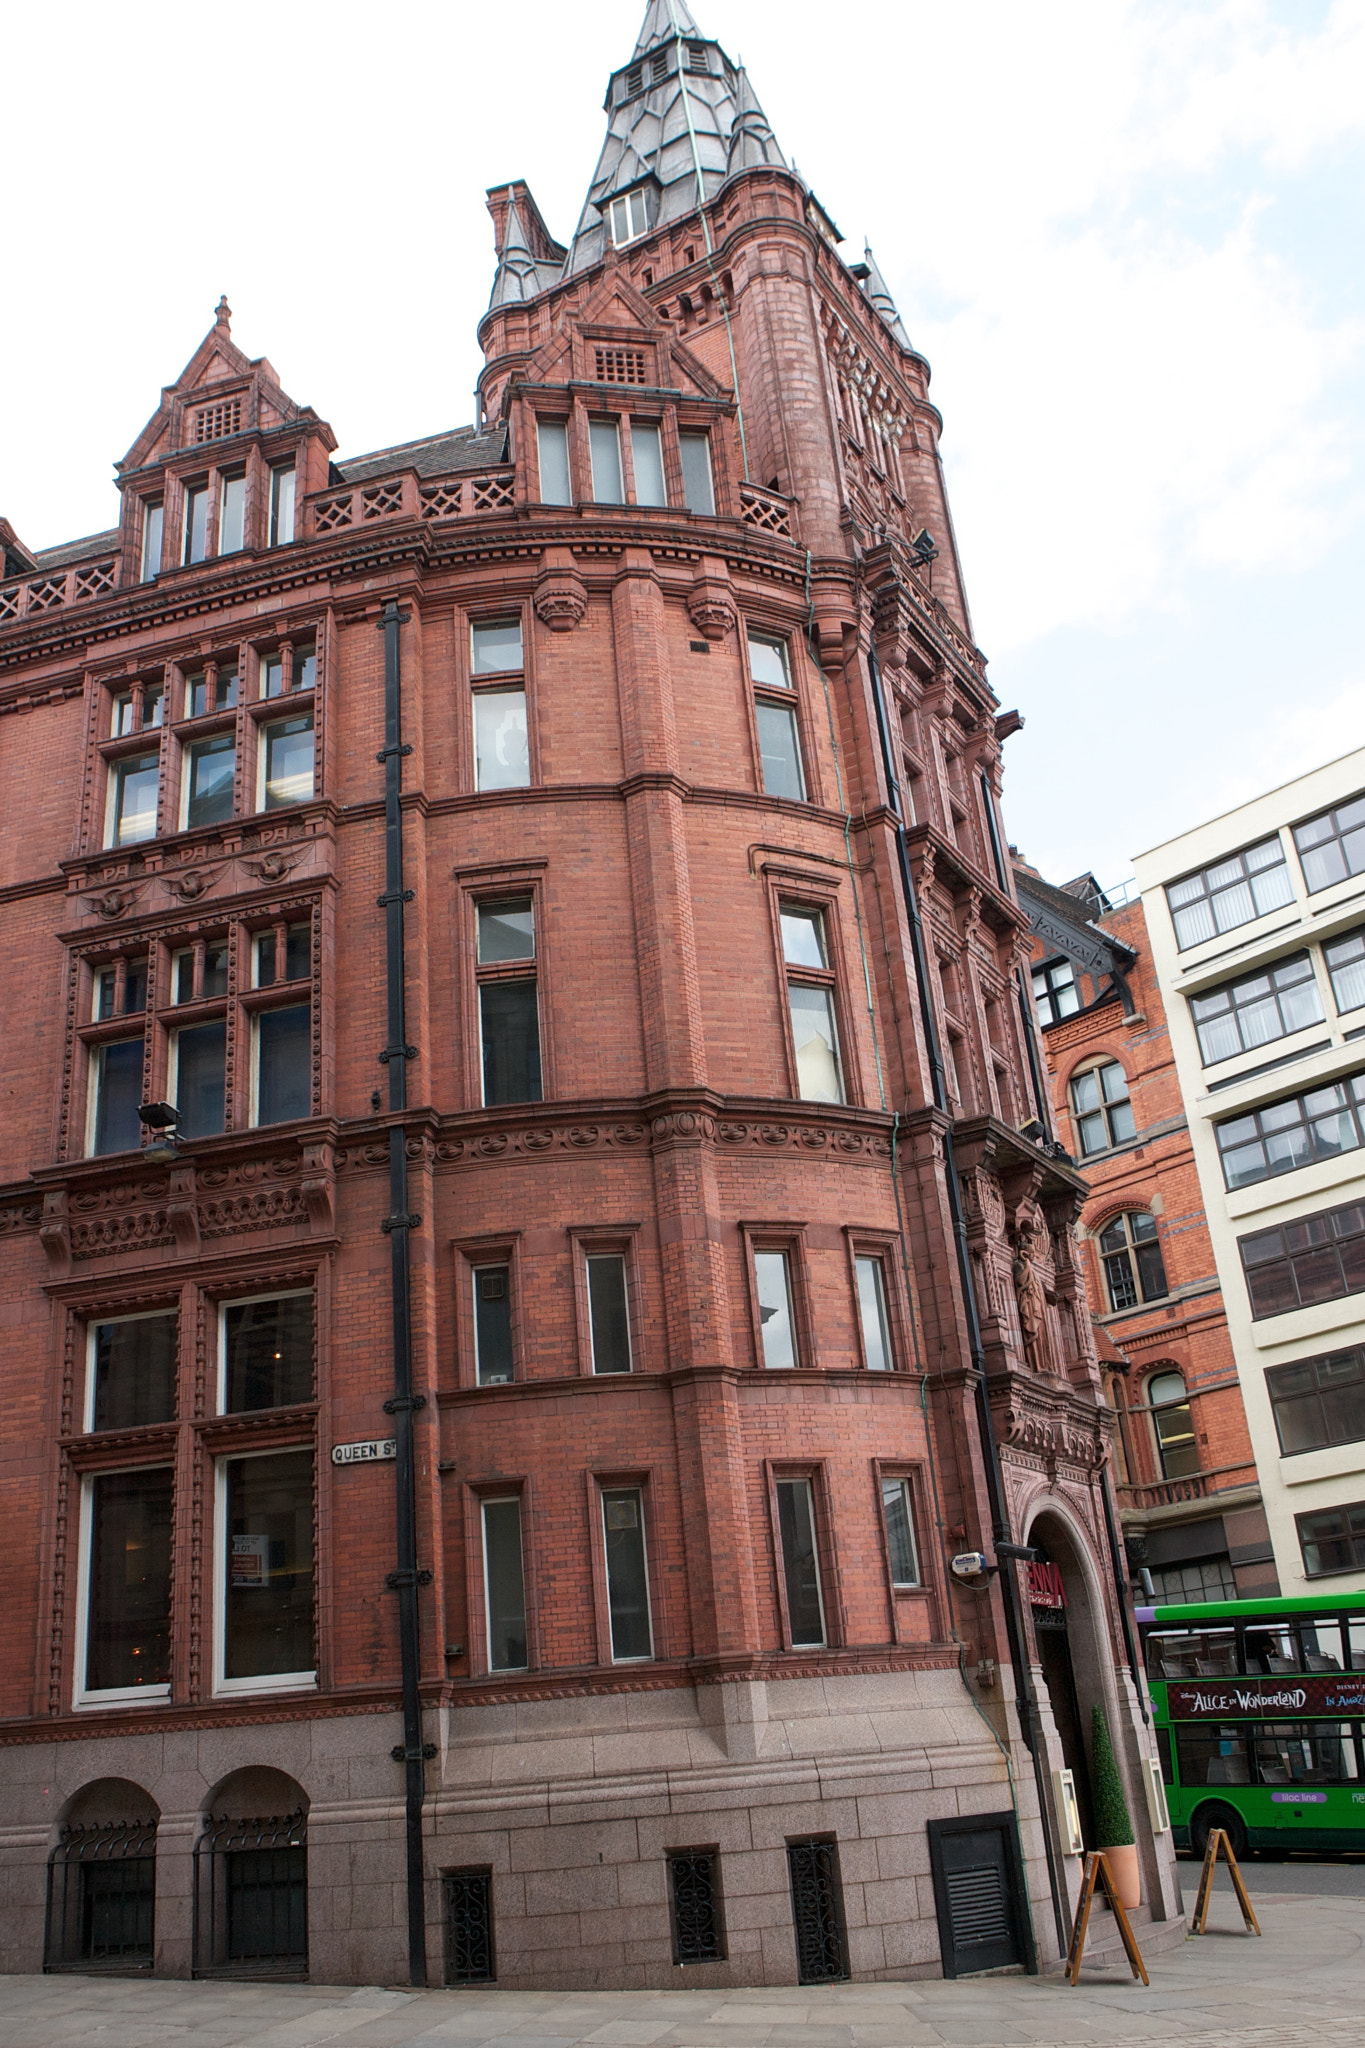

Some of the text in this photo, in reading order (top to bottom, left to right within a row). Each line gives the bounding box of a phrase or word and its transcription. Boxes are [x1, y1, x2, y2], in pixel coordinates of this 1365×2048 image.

[335, 1444, 377, 1461] QUEEN
[1281, 1793, 1318, 1802] lilac line
